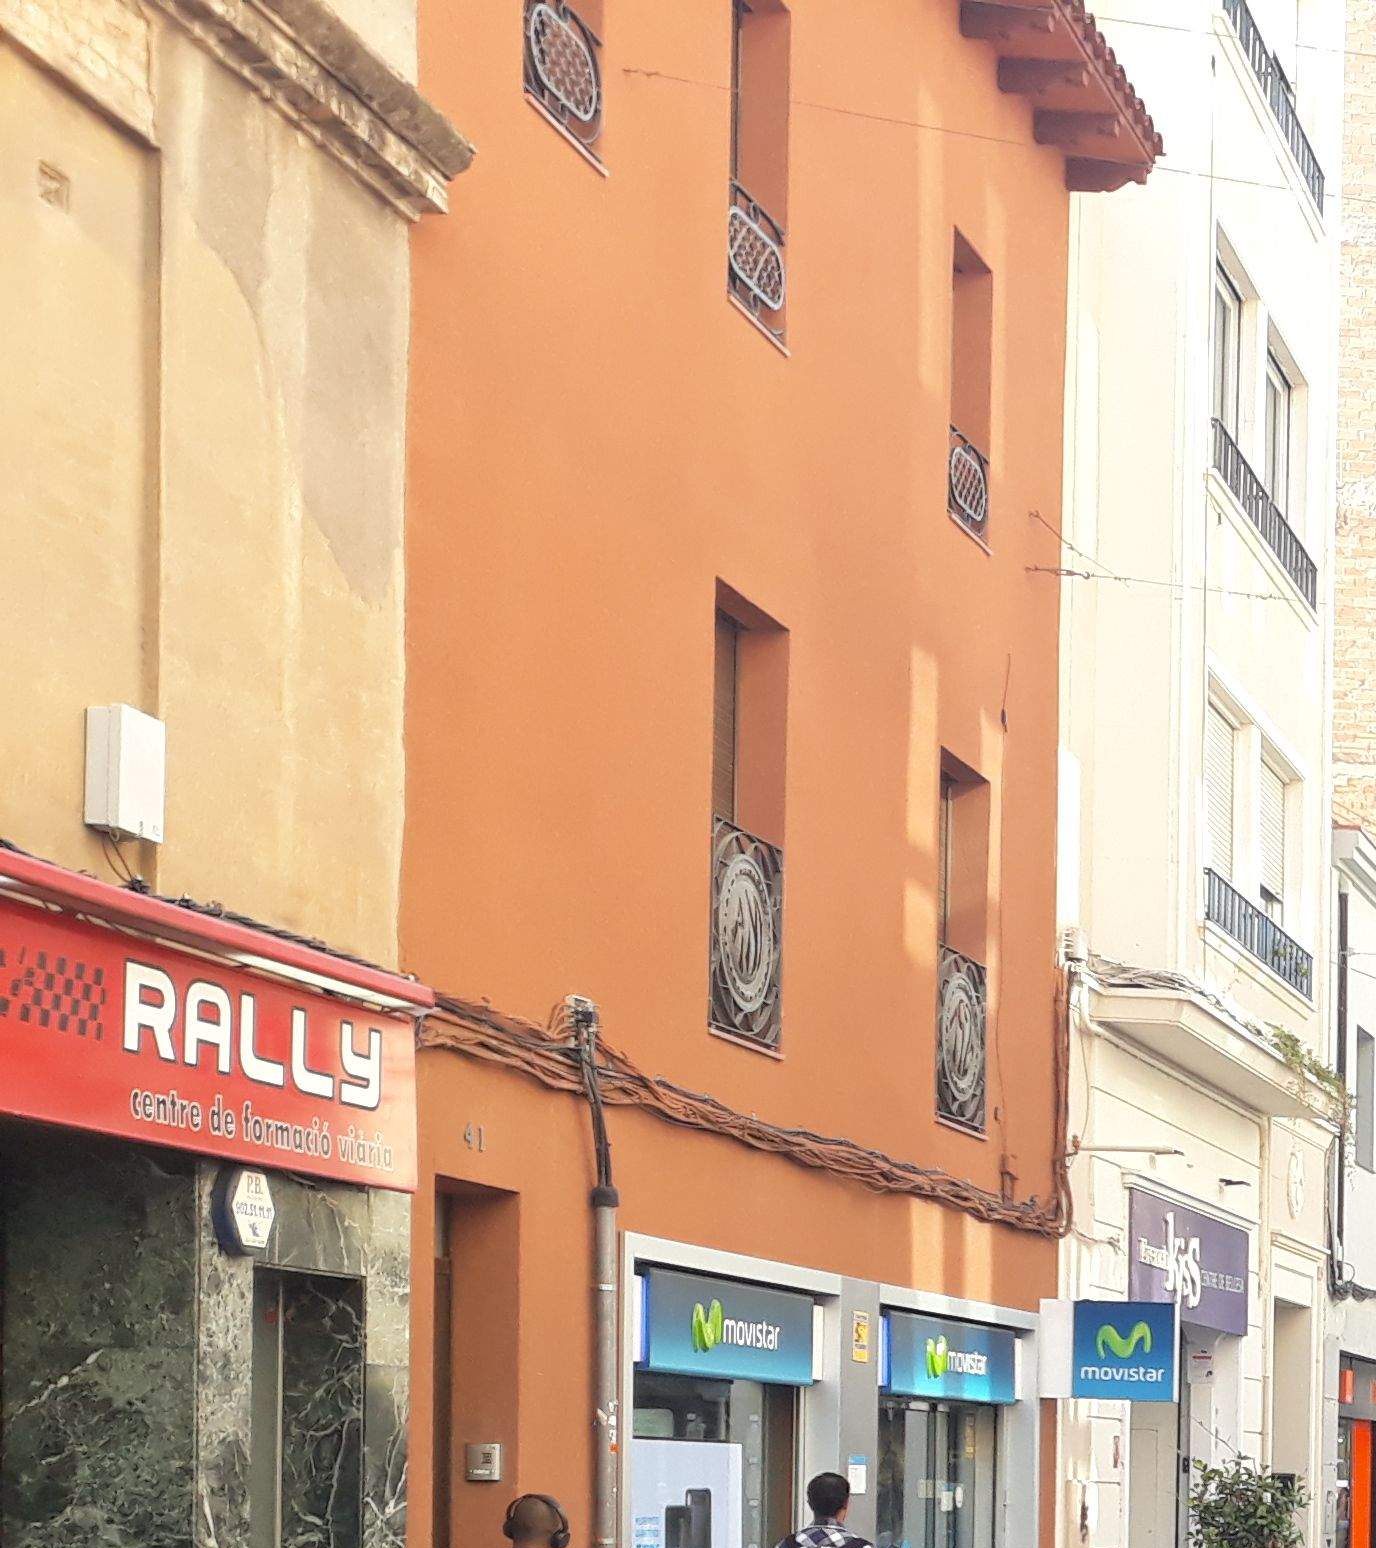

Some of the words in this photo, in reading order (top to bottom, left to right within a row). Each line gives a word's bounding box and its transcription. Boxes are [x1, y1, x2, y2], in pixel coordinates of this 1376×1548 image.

[122, 958, 382, 1111] RALLY
[131, 1089, 201, 1131] centre
[210, 1094, 236, 1138] de
[243, 1101, 331, 1159] formació
[723, 1318, 781, 1350] movistar
[947, 1350, 988, 1375] movistar
[1080, 1365, 1166, 1383] movistar
